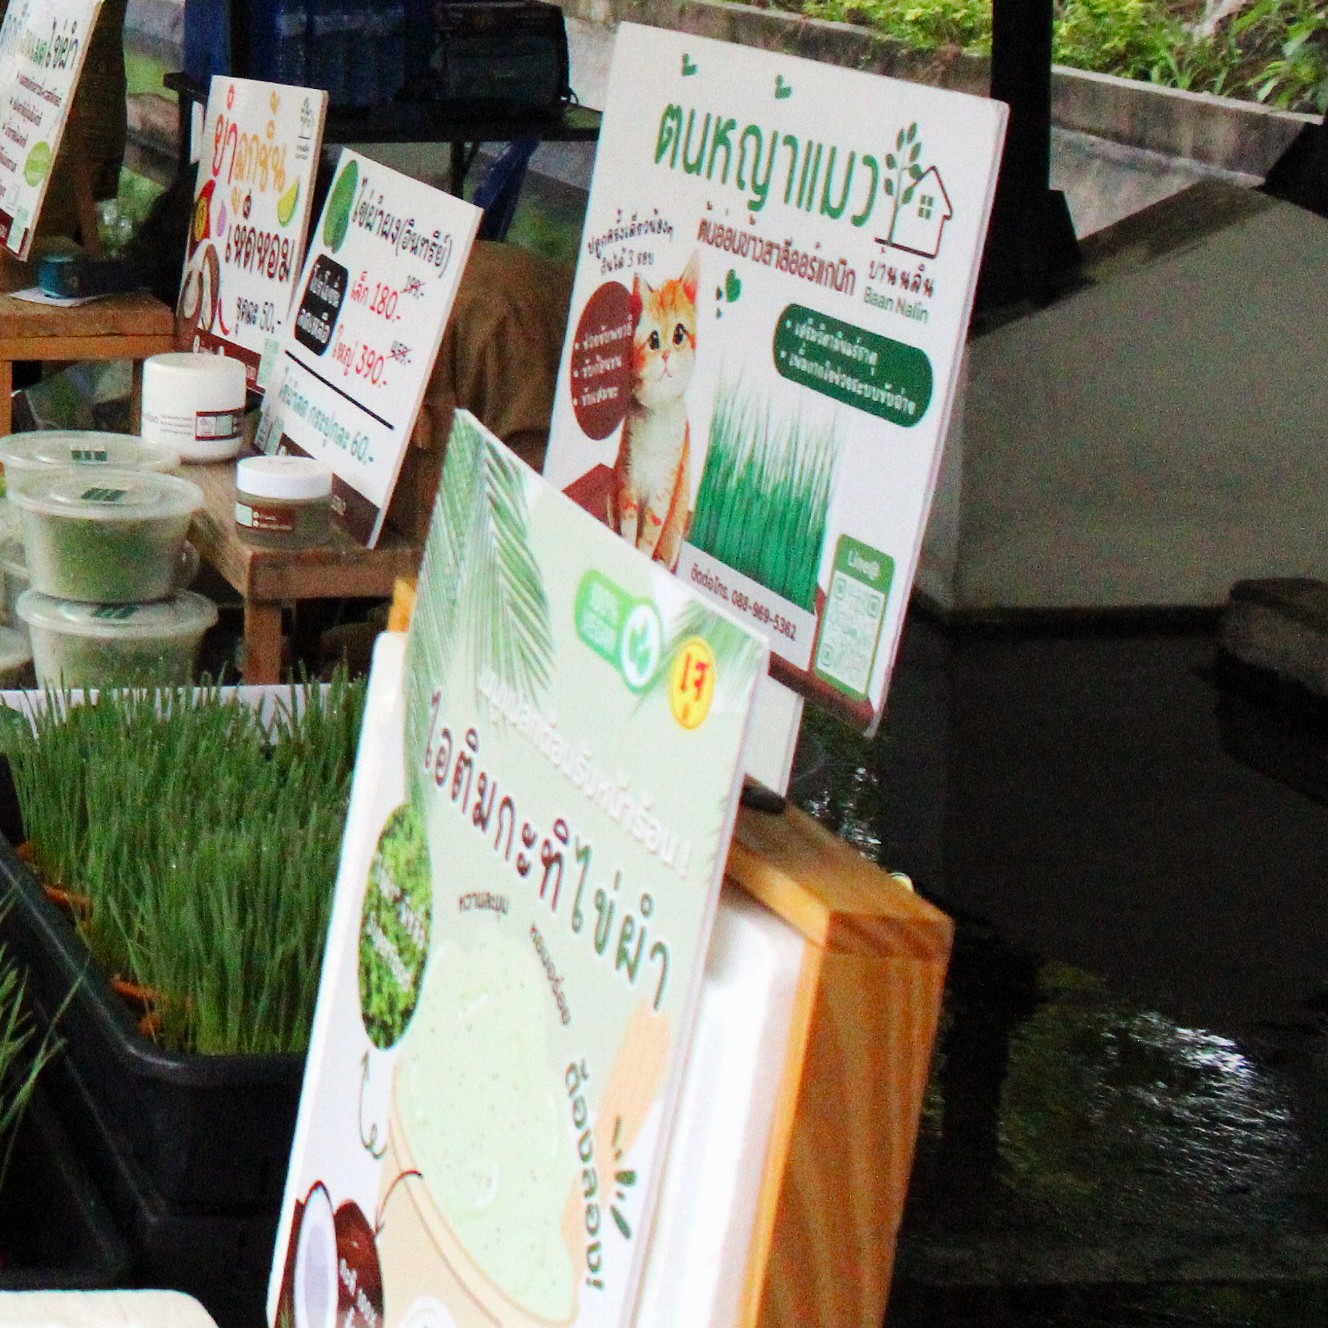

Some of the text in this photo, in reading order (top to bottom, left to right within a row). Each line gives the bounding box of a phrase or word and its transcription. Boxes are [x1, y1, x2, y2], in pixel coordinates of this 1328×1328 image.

[654, 53, 879, 227] ต้นหญ้าแมว
[697, 200, 856, 295] ต้นอ่อนข้าวสาลีออร์แกนิก
[863, 285, 929, 322] Baan Nalin
[869, 246, 935, 298] บ้านนลิน
[425, 687, 671, 1012] ไอติมกะทิไข่ผำ
[566, 1058, 605, 1291] ต้องลอง!
